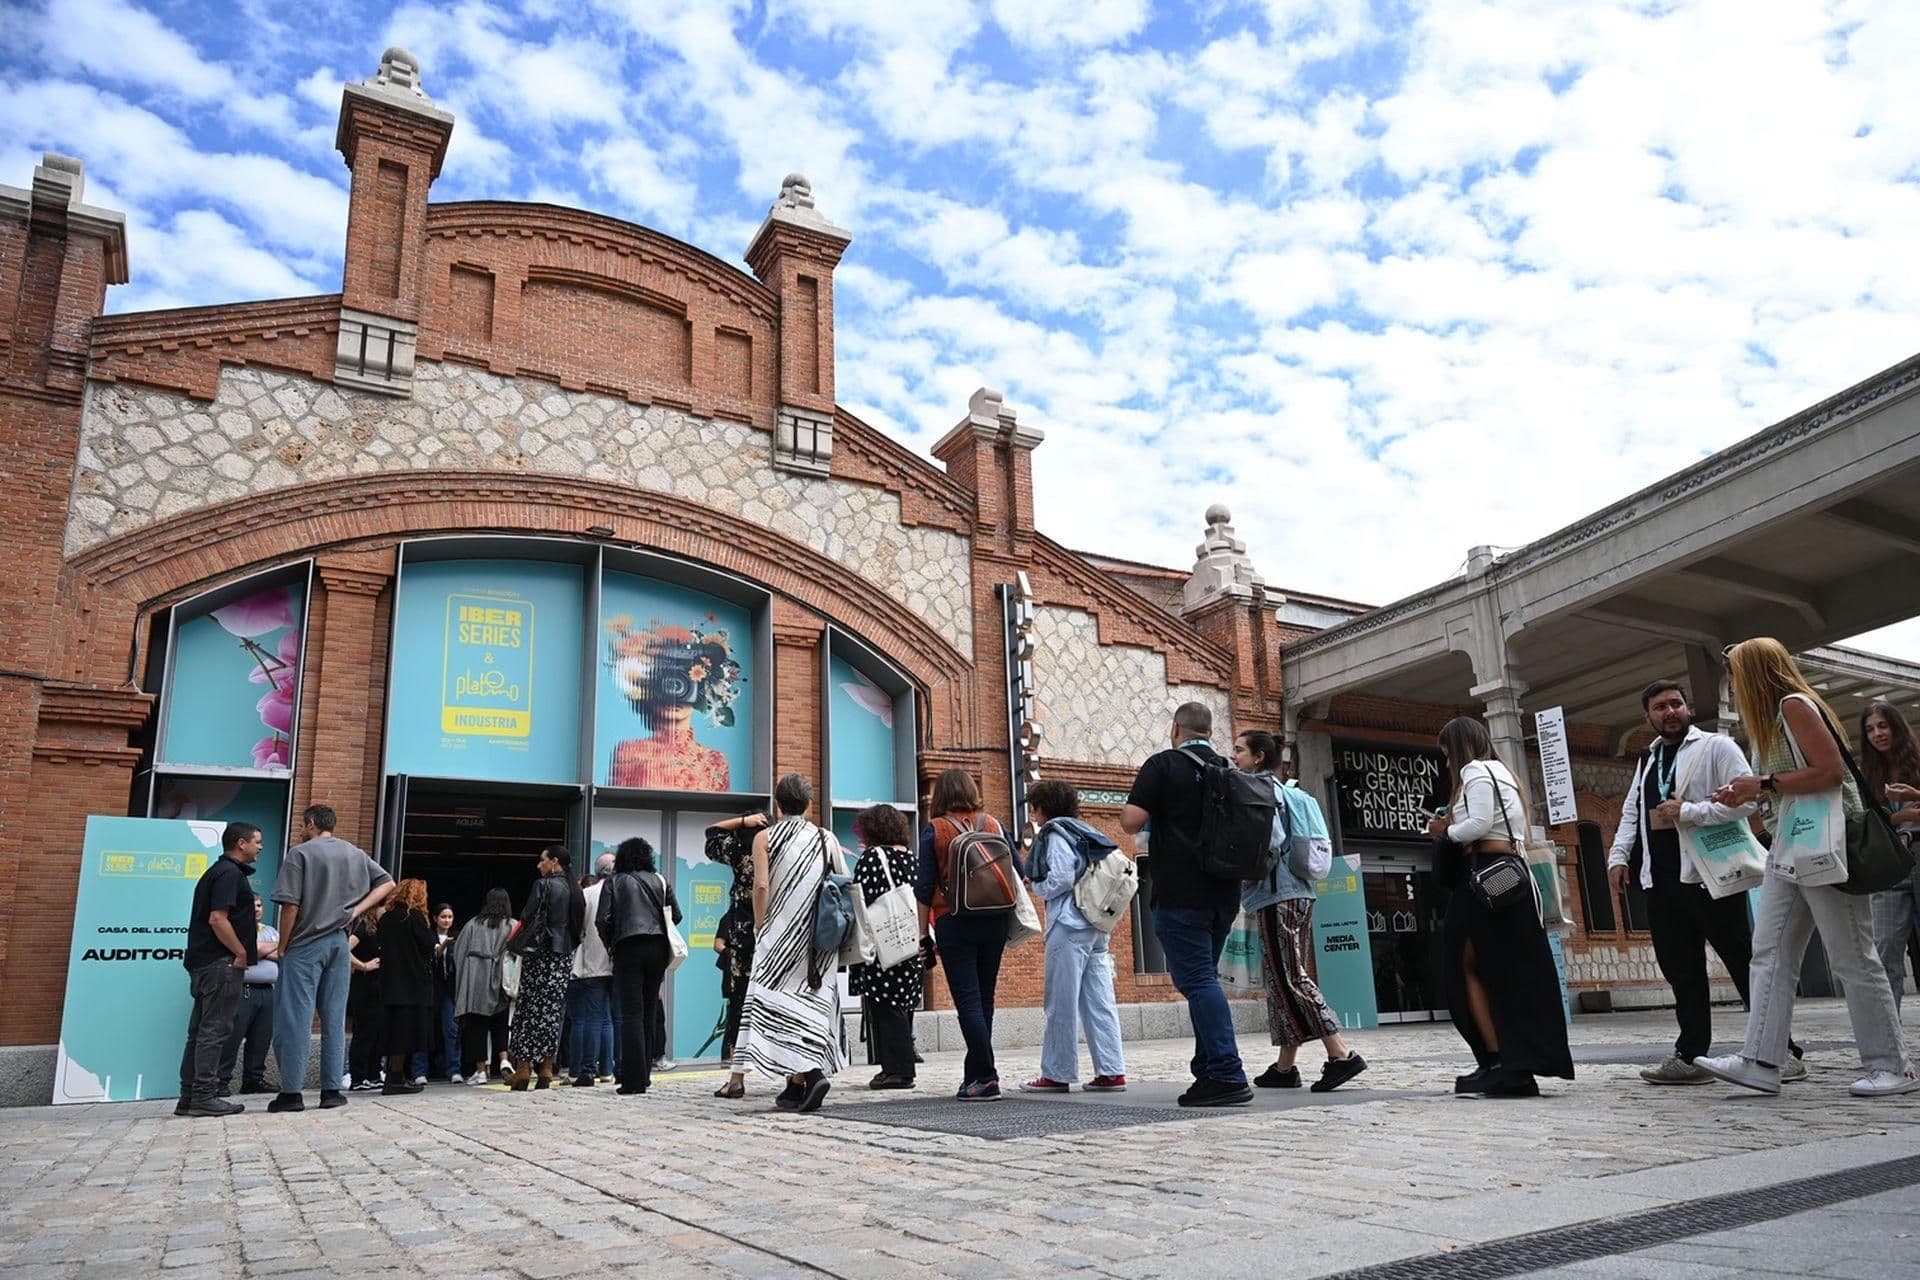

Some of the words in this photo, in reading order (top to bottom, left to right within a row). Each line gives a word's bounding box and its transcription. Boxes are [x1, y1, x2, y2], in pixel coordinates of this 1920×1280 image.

[460, 606, 522, 626] IBER
[458, 623, 521, 648] SERIES
[484, 651, 496, 664] &
[455, 714, 518, 729] INDUSTRIA
[1344, 751, 1440, 777] FUNDACIÓN
[1365, 772, 1434, 795] GERMÁN
[1352, 790, 1425, 812] SÁNCHEZ
[98, 926, 128, 934] CASA
[131, 926, 151, 934] DEL
[154, 926, 190, 934] LECTO
[1323, 942, 1360, 953] CENTER
[1326, 934, 1355, 944] MEDIA
